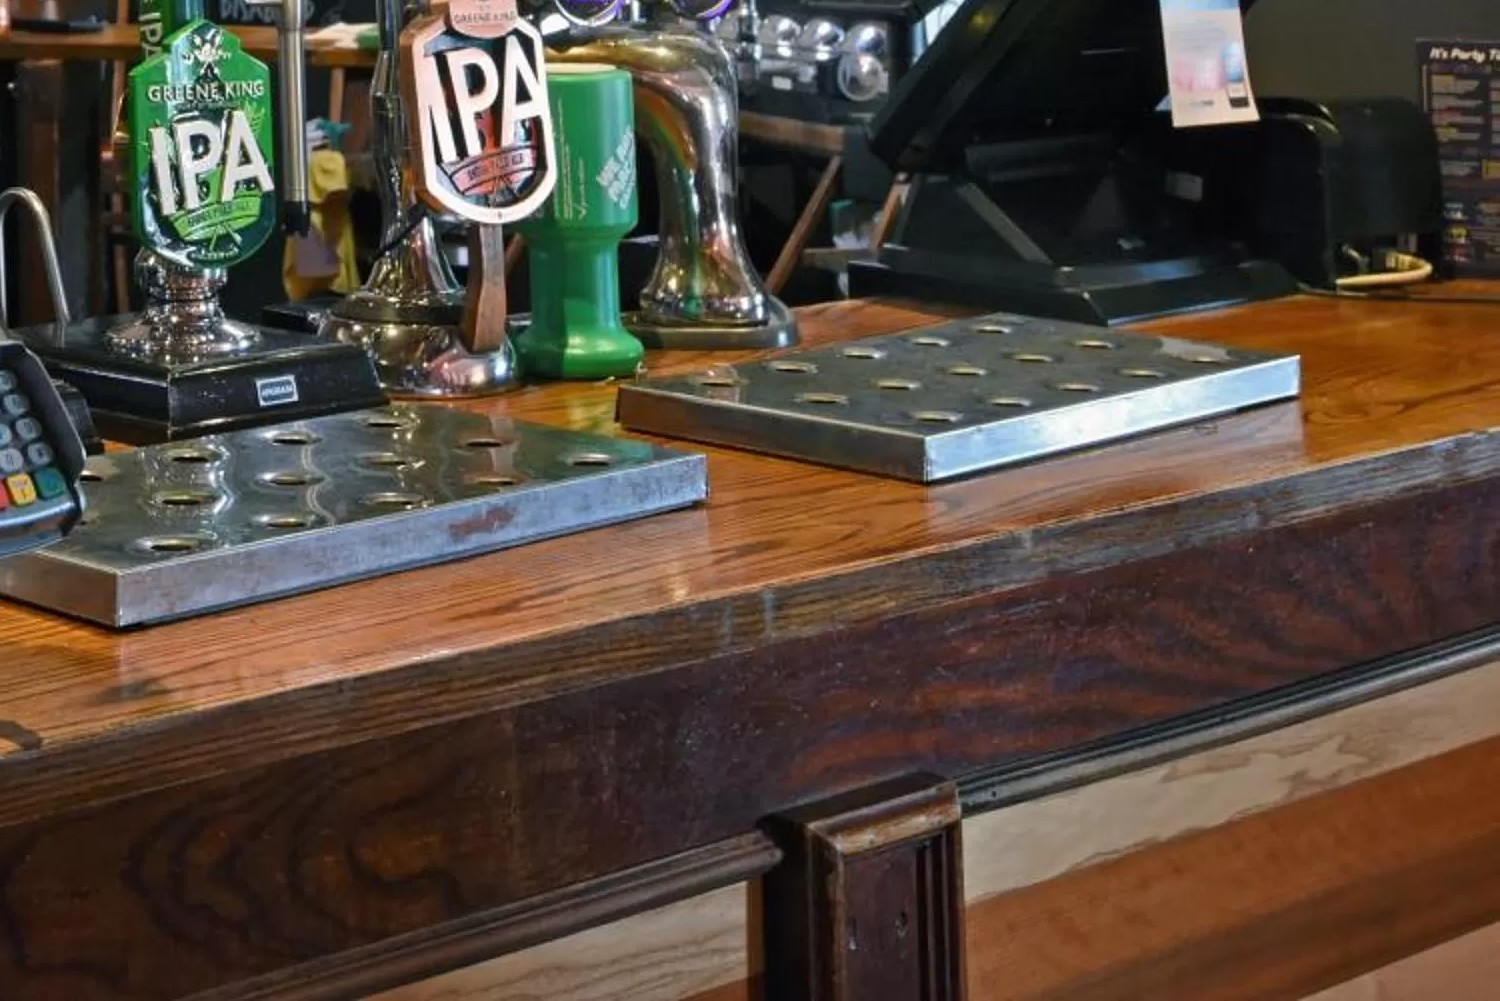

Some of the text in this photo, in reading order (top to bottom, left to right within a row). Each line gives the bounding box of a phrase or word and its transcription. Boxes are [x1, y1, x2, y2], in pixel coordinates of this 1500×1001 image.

[147, 79, 265, 103] GREENE KING
[414, 35, 550, 163] IPA
[148, 109, 274, 217] IPA
